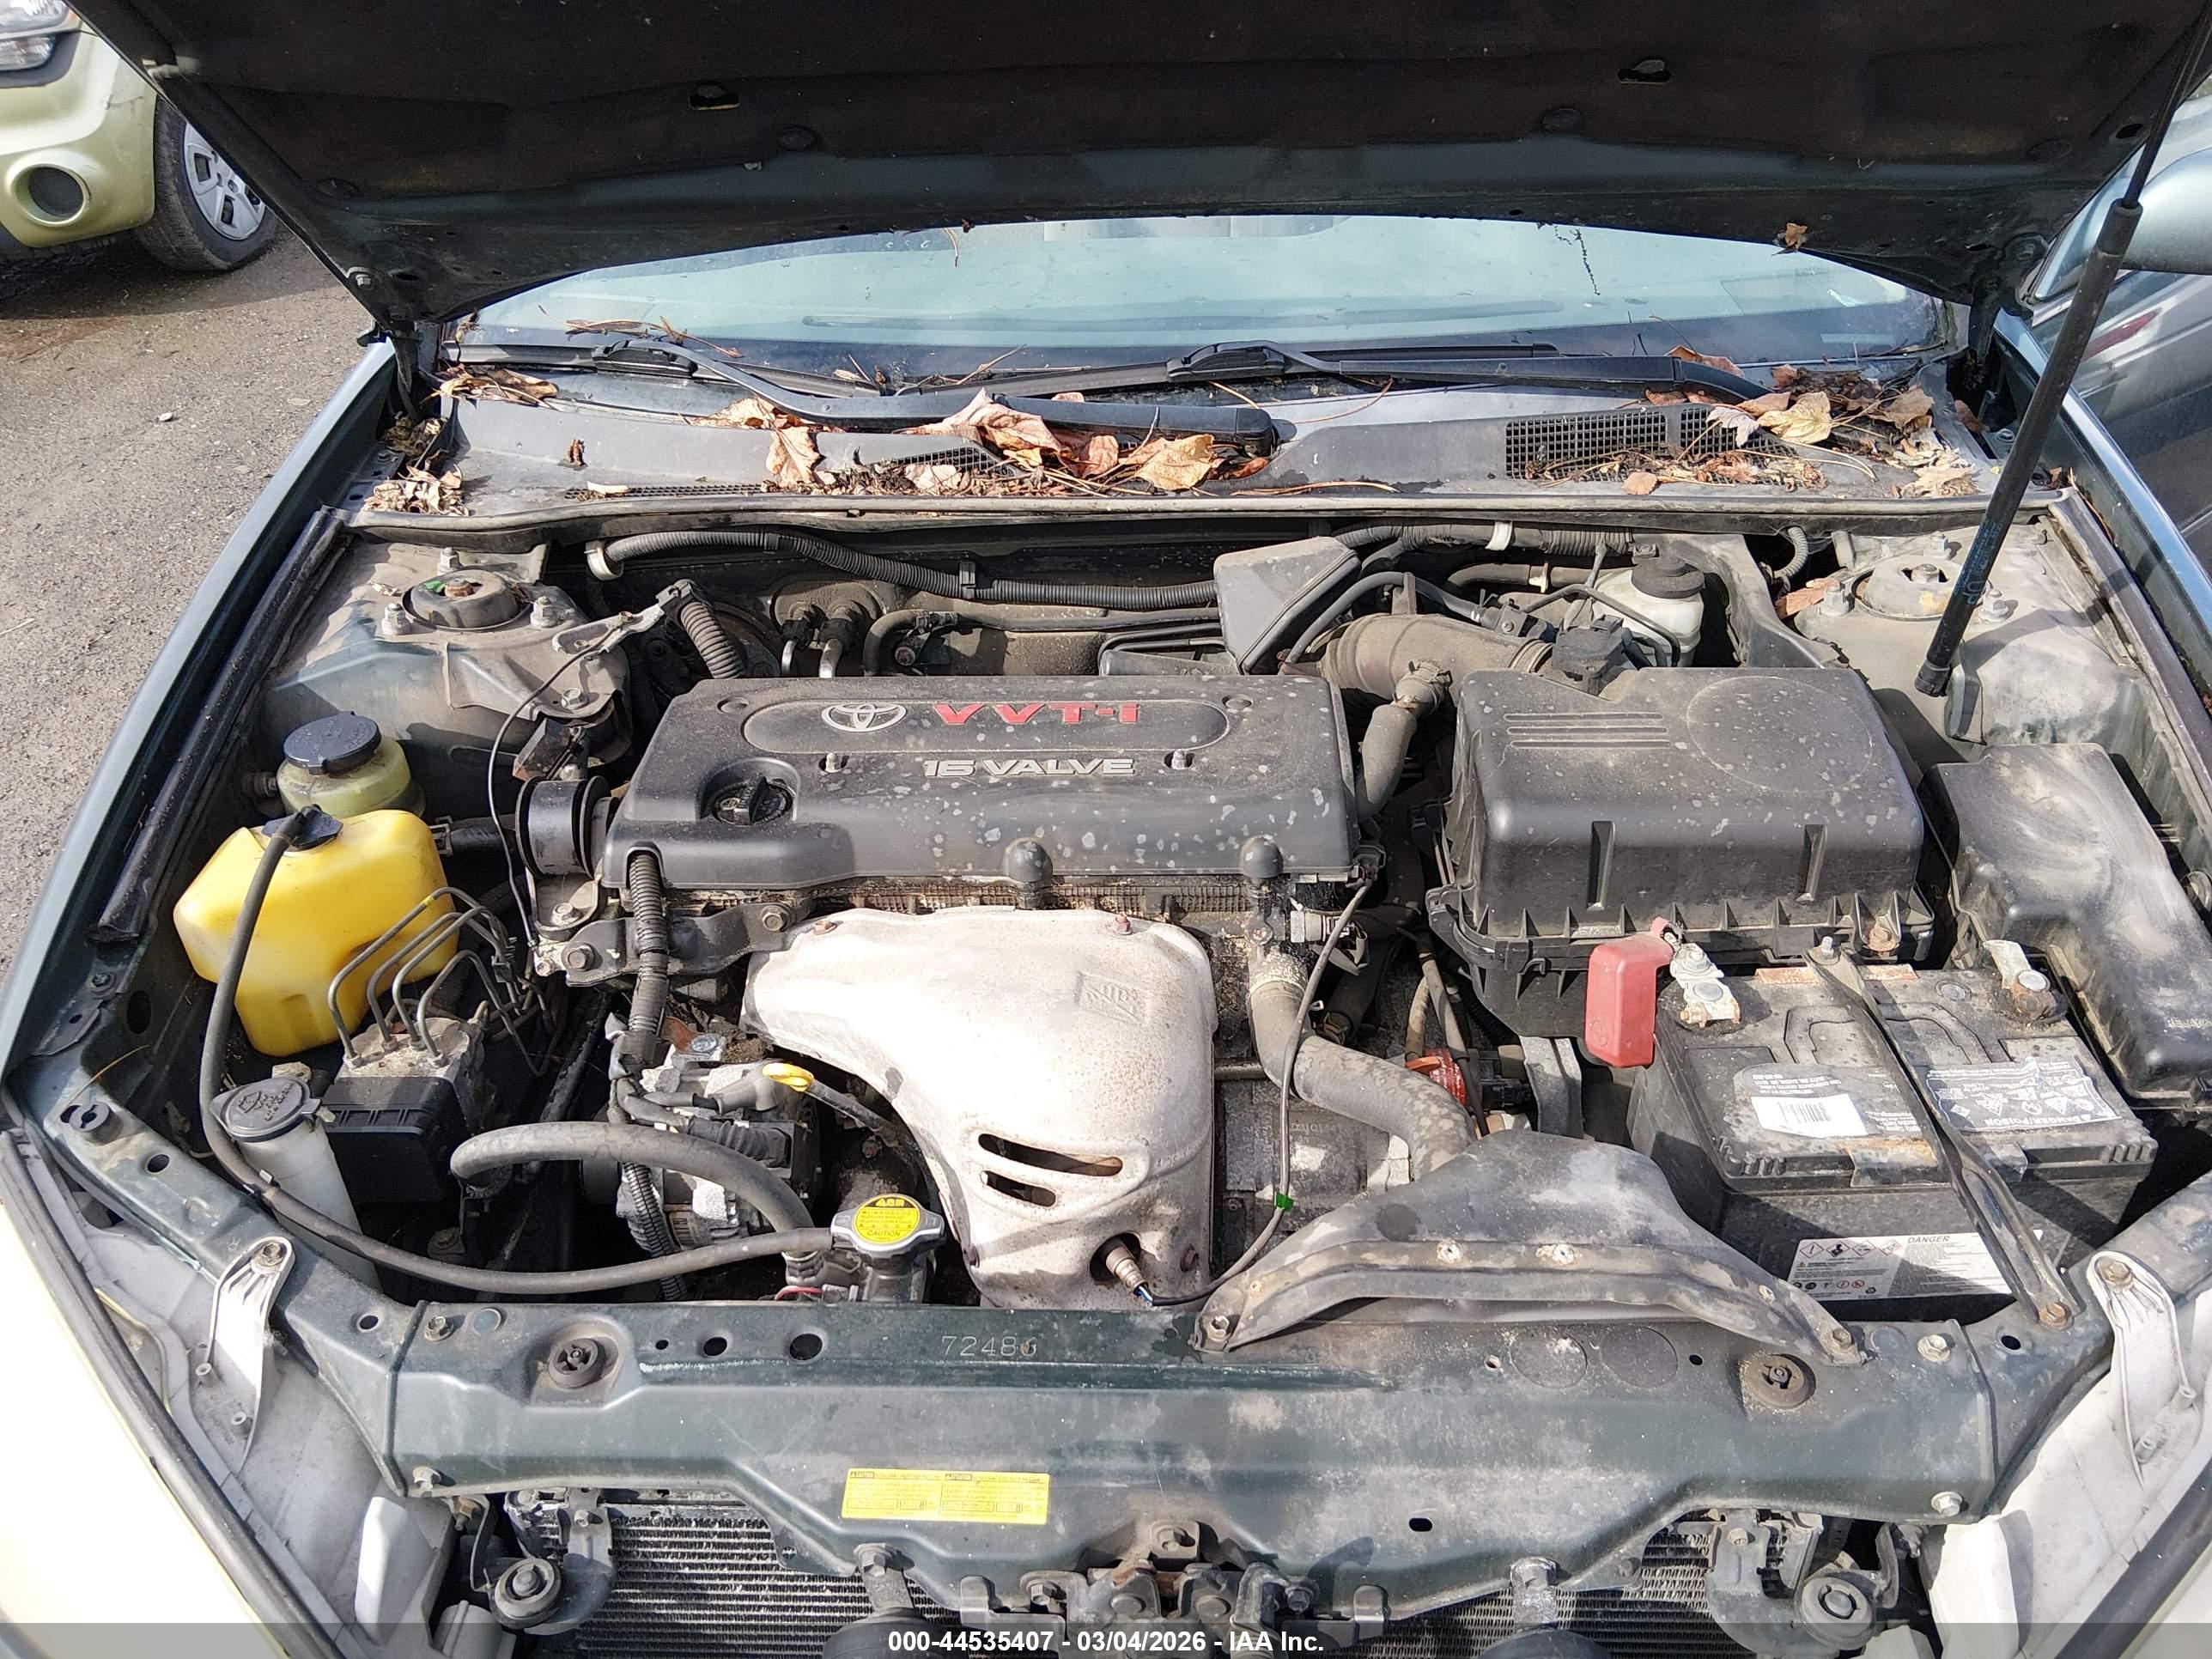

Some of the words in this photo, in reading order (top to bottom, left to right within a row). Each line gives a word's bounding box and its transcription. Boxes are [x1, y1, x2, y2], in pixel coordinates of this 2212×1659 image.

[923, 758, 976, 777] 16
[981, 757, 1136, 776] VALVE
[1984, 1115, 2081, 1127] DANGER/POISON
[941, 1335, 1037, 1357] 72486
